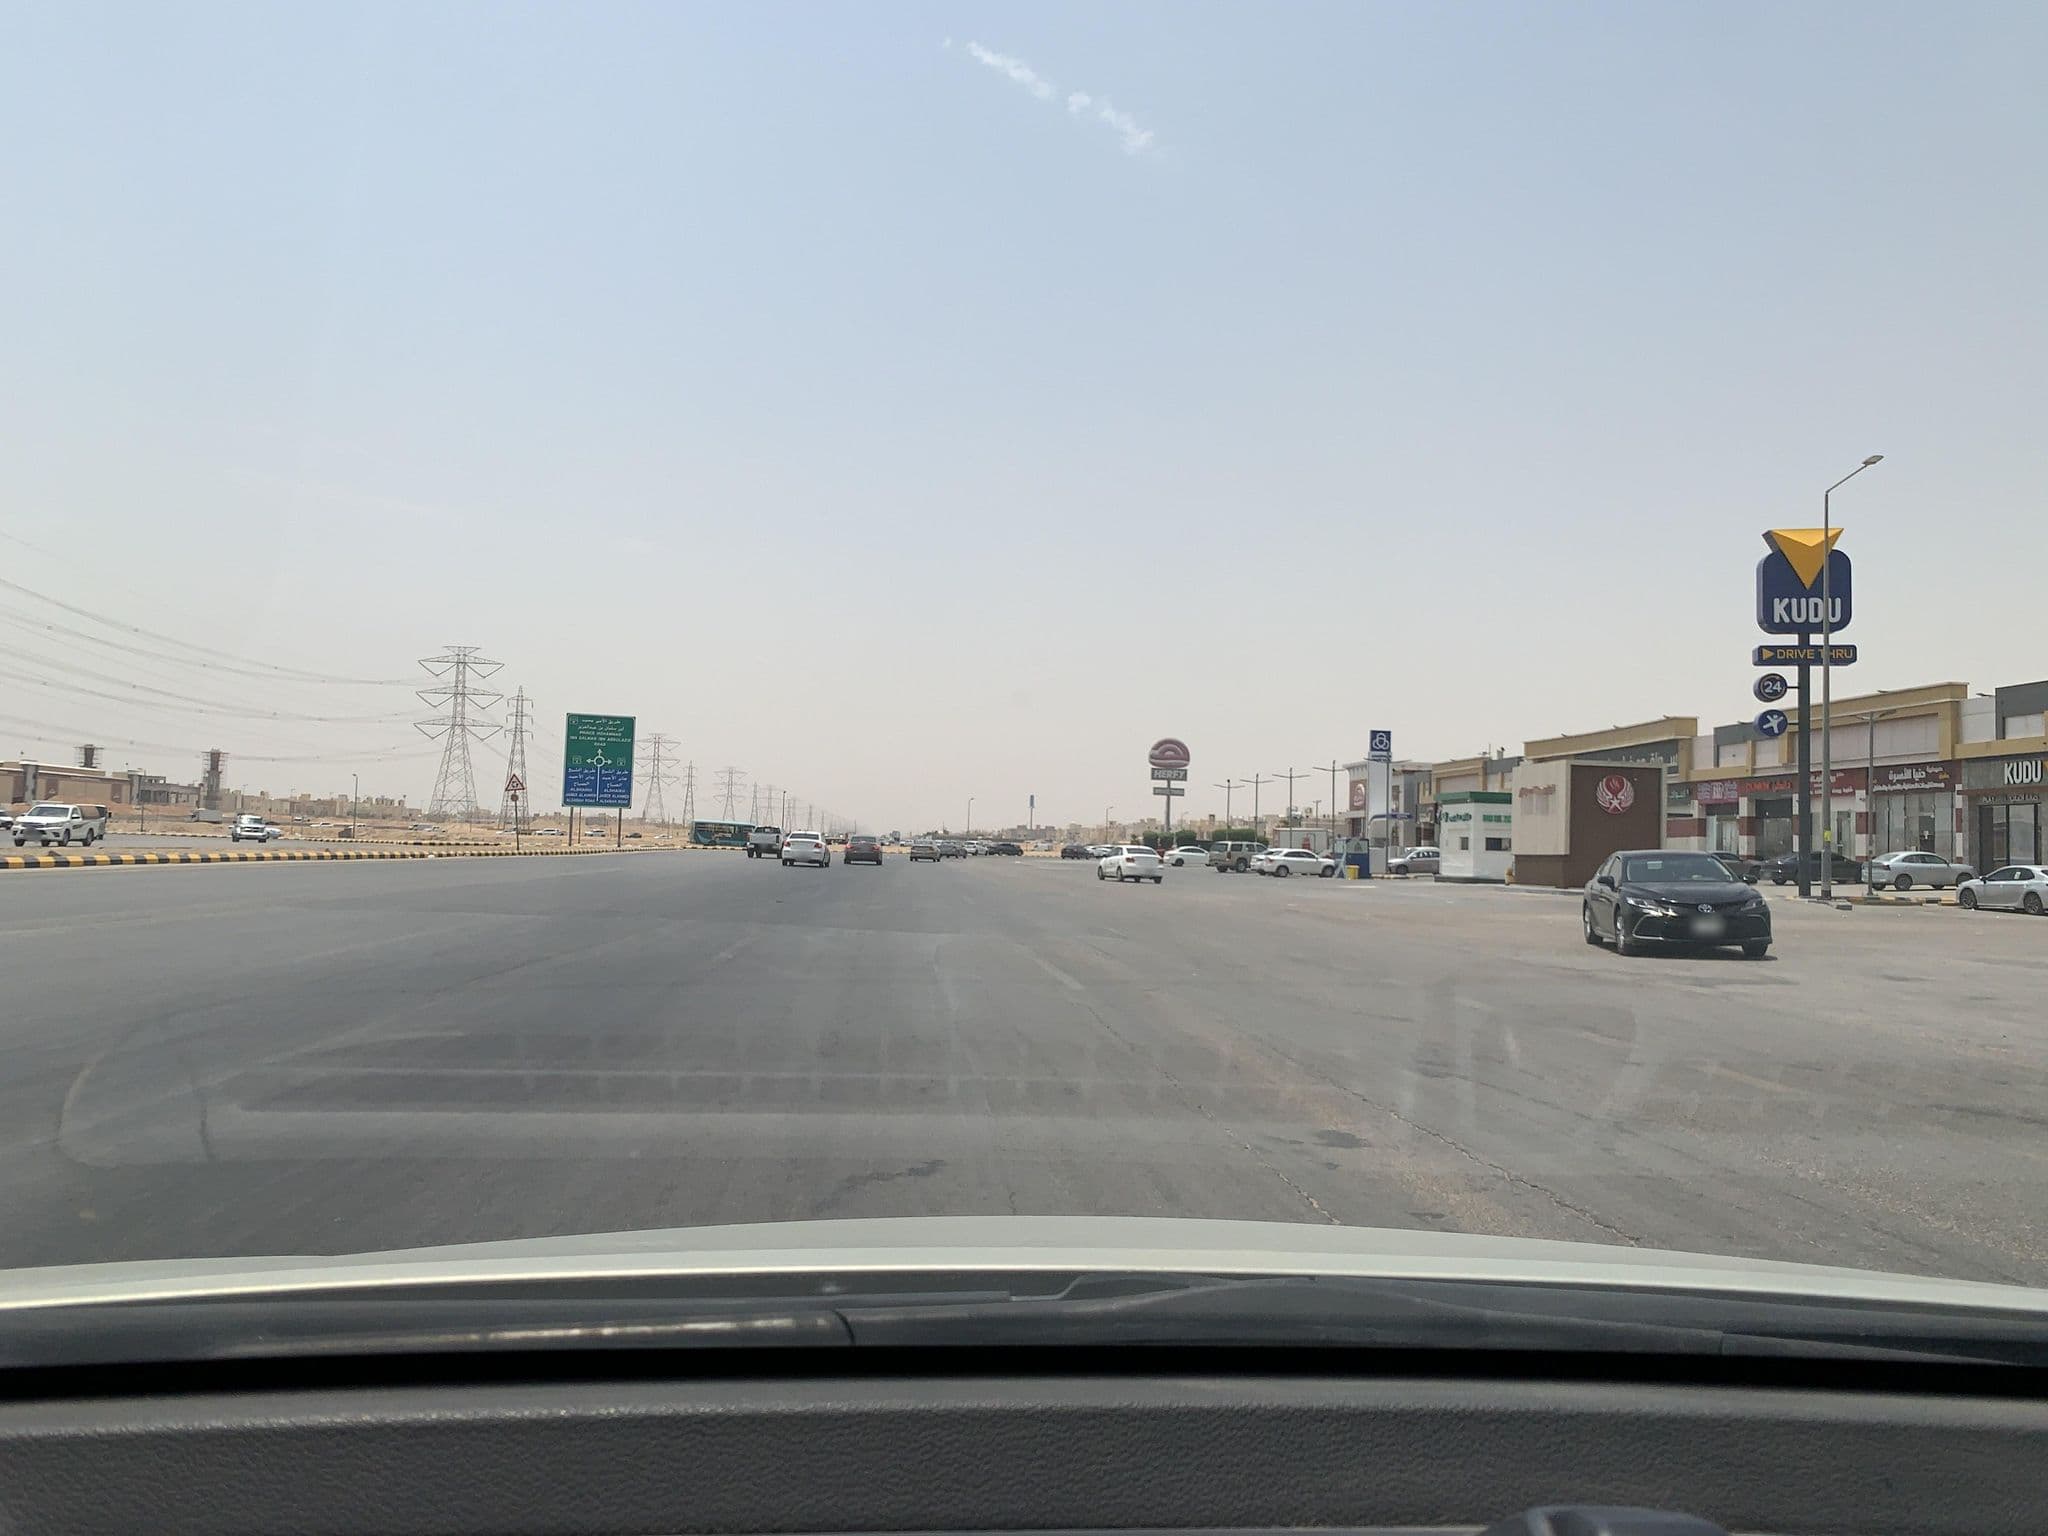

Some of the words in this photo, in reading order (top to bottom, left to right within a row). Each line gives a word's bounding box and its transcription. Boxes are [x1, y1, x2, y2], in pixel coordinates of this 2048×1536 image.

[1773, 597, 1842, 624] KUDU
[1777, 648, 1814, 659] DRIVE
[1764, 680, 1782, 693] 24
[2004, 760, 2042, 784] KUDU
